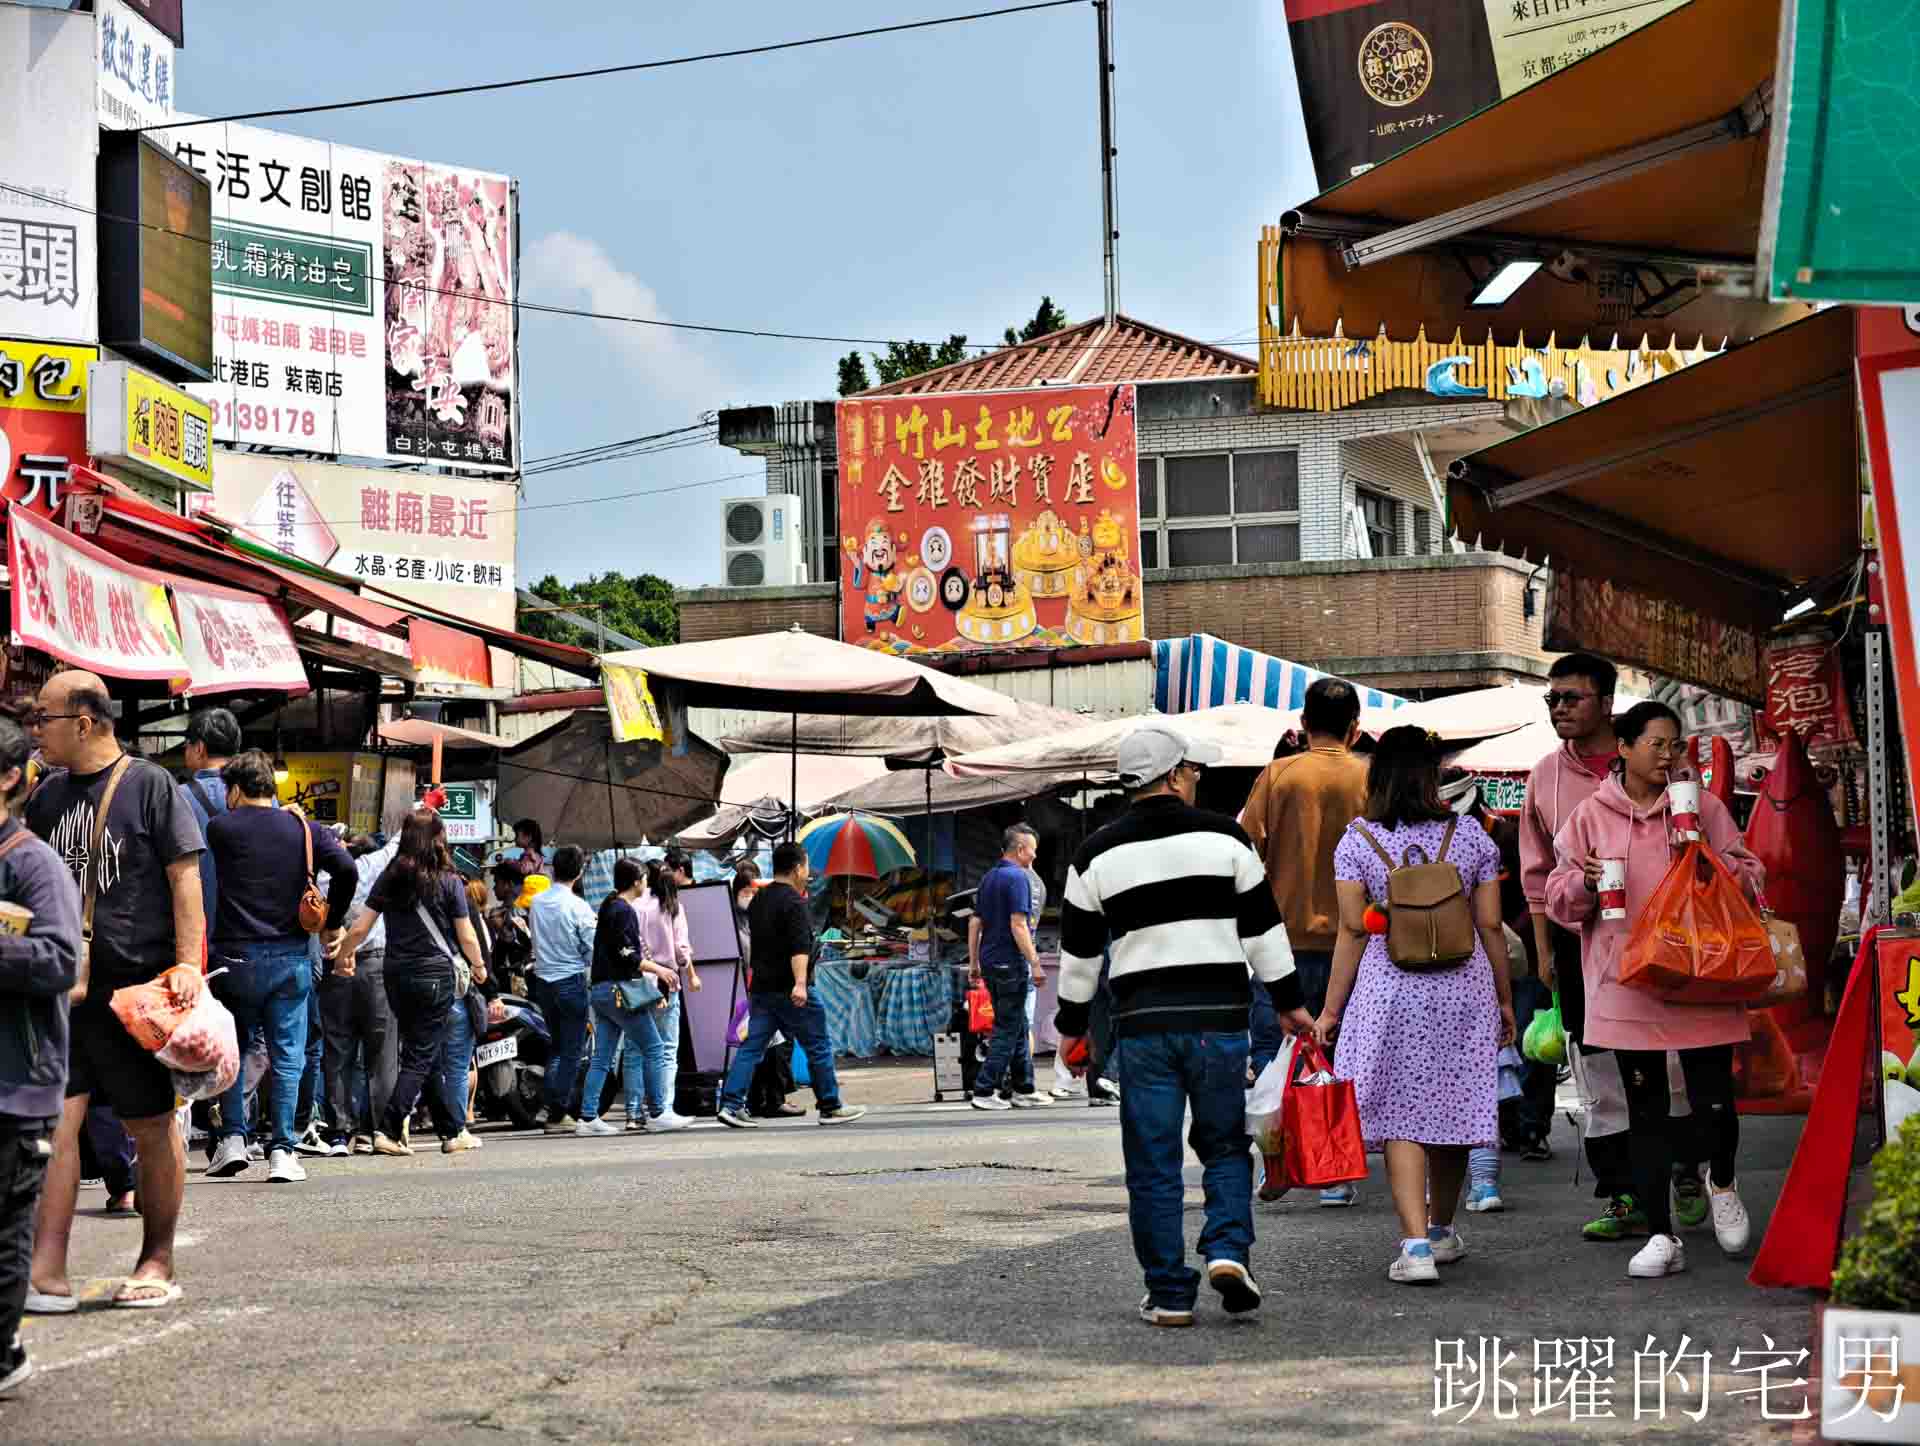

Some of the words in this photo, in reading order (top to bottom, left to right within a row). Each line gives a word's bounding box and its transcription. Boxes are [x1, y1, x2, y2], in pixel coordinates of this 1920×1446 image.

[174, 141, 372, 221] 生活文創館
[212, 238, 355, 292] 乳霜精油皂
[213, 314, 300, 349] 屯媽祖廟
[309, 325, 367, 357] 選用皂
[213, 355, 270, 389] 北港店
[285, 364, 343, 397] 紫南店
[394, 436, 506, 461] 白沙屯媽祖
[895, 404, 1074, 458] 竹山土地公
[18, 453, 70, 508] 元
[877, 452, 1097, 511] 金雞發財寶座
[360, 486, 489, 540] 離廟最近
